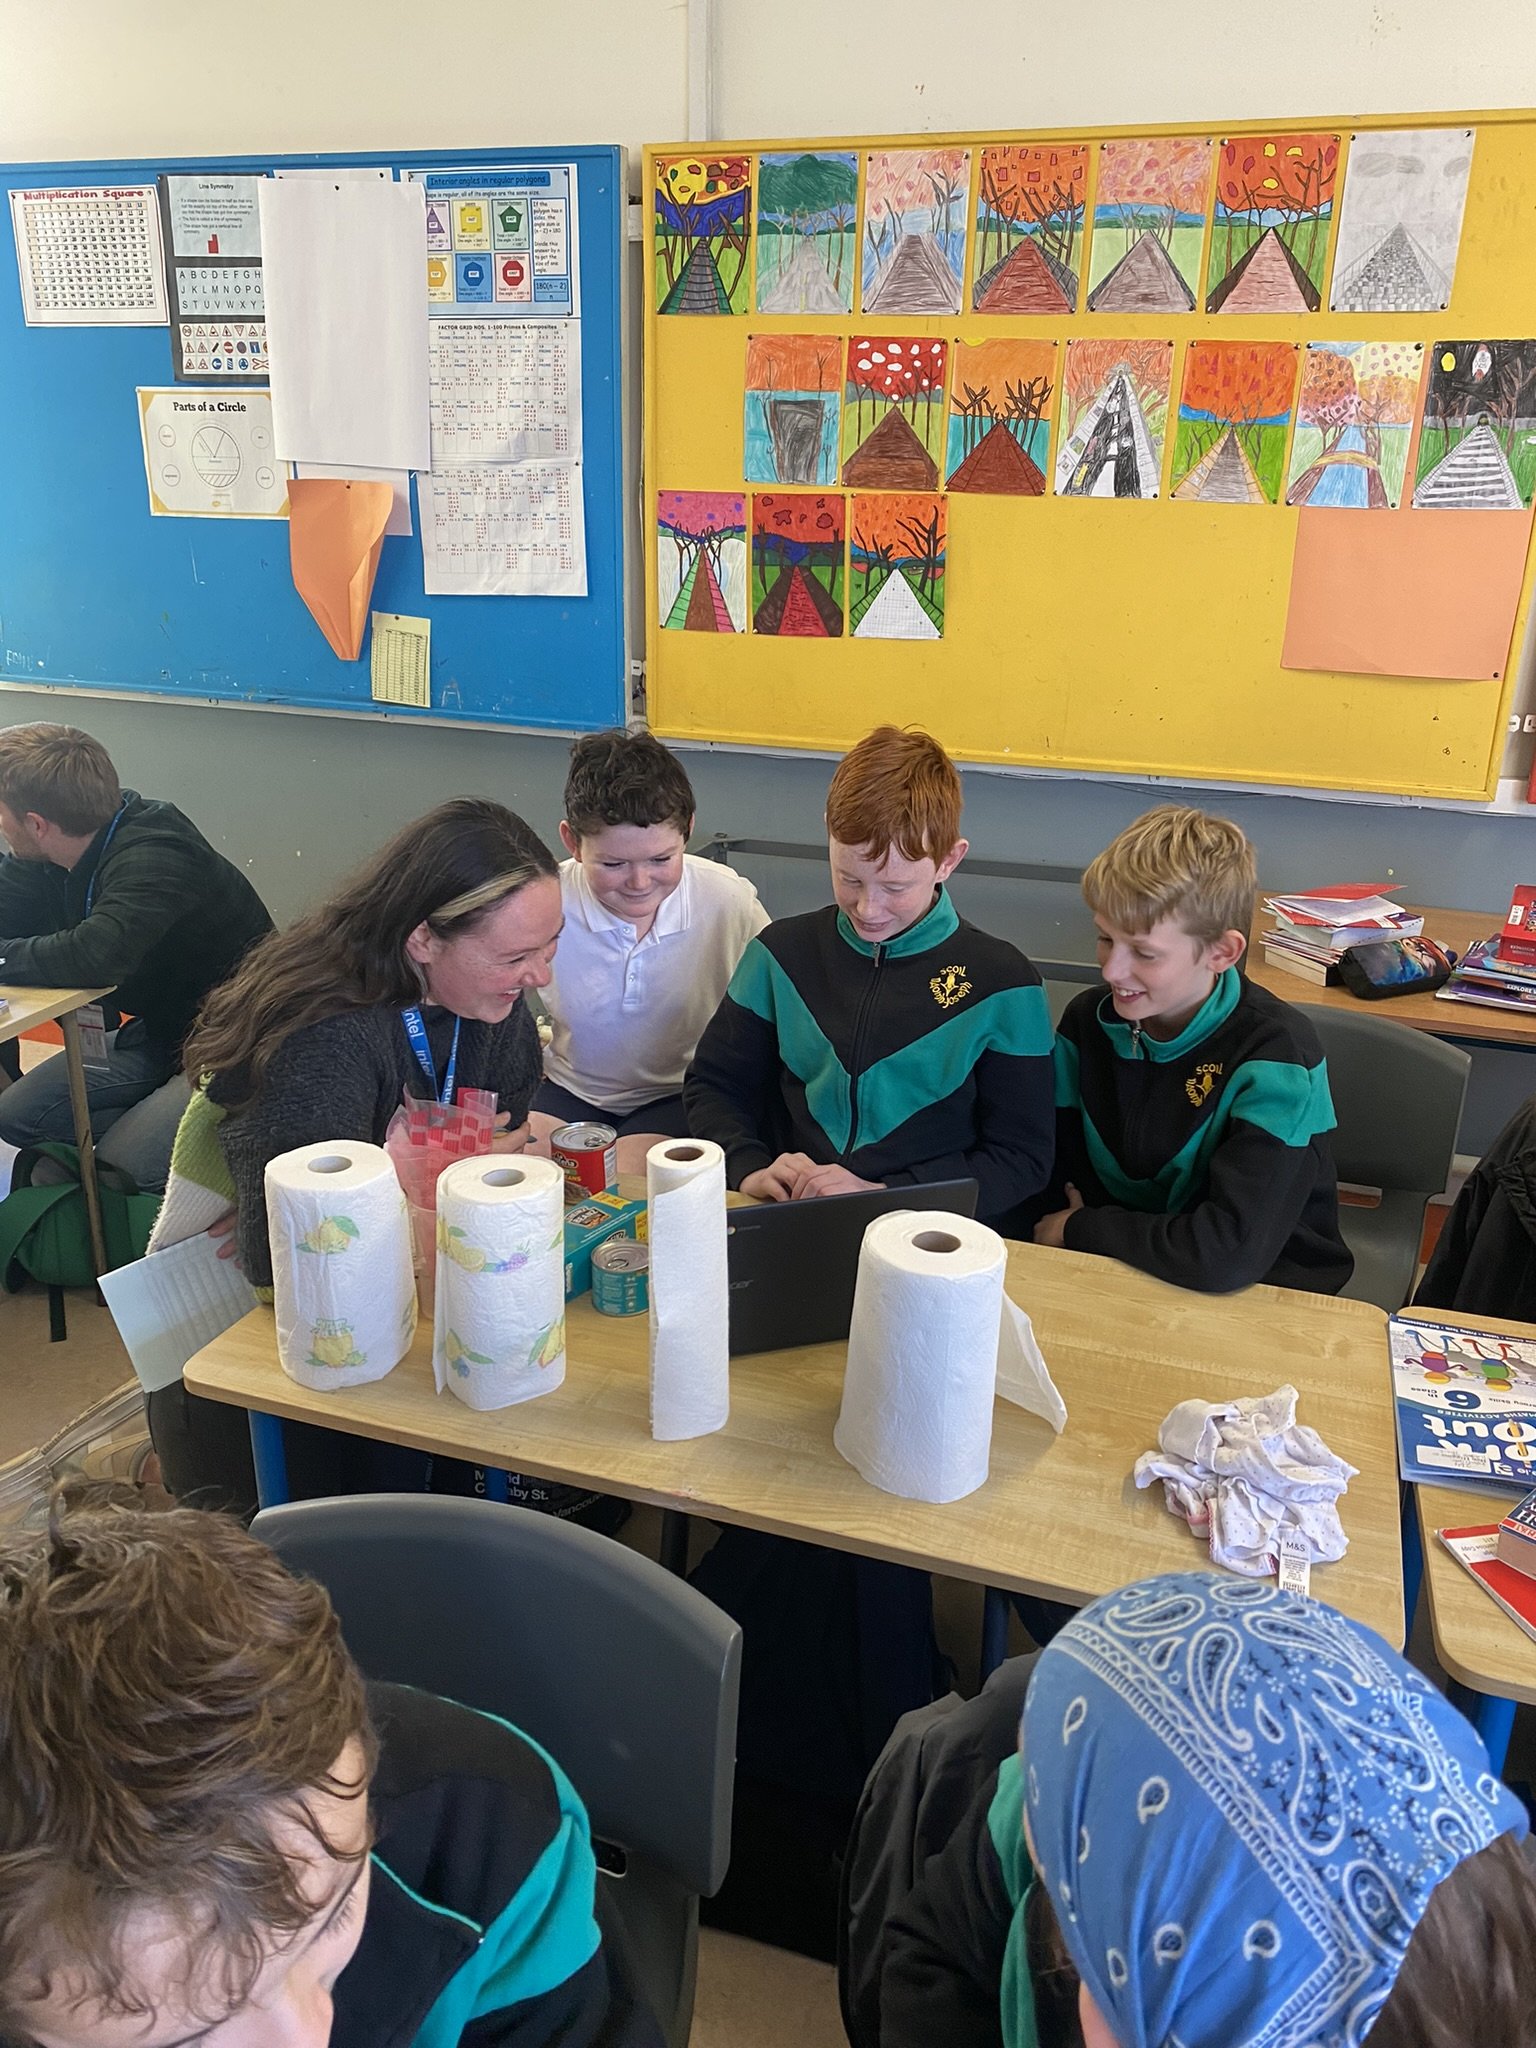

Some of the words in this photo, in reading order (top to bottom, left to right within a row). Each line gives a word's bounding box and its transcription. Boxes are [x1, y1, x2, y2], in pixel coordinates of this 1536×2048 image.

[430, 177, 458, 186] Interior
[459, 177, 480, 187] angles
[490, 176, 514, 185] regular
[515, 174, 546, 184] polygons
[23, 190, 98, 202] Multiplication
[103, 190, 144, 200] Square
[179, 271, 186, 279] A
[191, 271, 197, 279] B
[201, 271, 207, 279] C
[212, 271, 218, 279] D
[223, 271, 229, 279] E
[234, 271, 239, 279] F
[243, 271, 250, 279] G
[254, 271, 261, 279] H
[181, 285, 185, 294] J
[191, 285, 197, 294] K
[202, 285, 207, 294] L
[212, 285, 219, 294] M
[223, 285, 229, 294] N
[234, 285, 241, 294] O
[245, 285, 251, 294] P
[254, 285, 261, 294] Q
[182, 301, 188, 309] S
[193, 301, 198, 309] T
[204, 301, 210, 309] U
[214, 301, 220, 309] V
[226, 301, 234, 309] W
[240, 301, 246, 309] X
[250, 301, 256, 309] Y
[173, 401, 196, 411] Parts
[198, 401, 207, 412] of
[208, 404, 215, 412] a
[217, 402, 247, 412] Circle
[1507, 984, 1533, 994] EXPLORE
[1196, 1063, 1223, 1075] SCOIL
[728, 1280, 754, 1290] cer
[1444, 1390, 1481, 1410] 6
[1437, 1409, 1500, 1419] ACTIVITIES
[1422, 1414, 1536, 1443] Out
[475, 1470, 520, 1485] Mid
[531, 1489, 549, 1501] St.
[553, 1493, 605, 1517] Vancou
[1286, 1541, 1305, 1552] M&S
